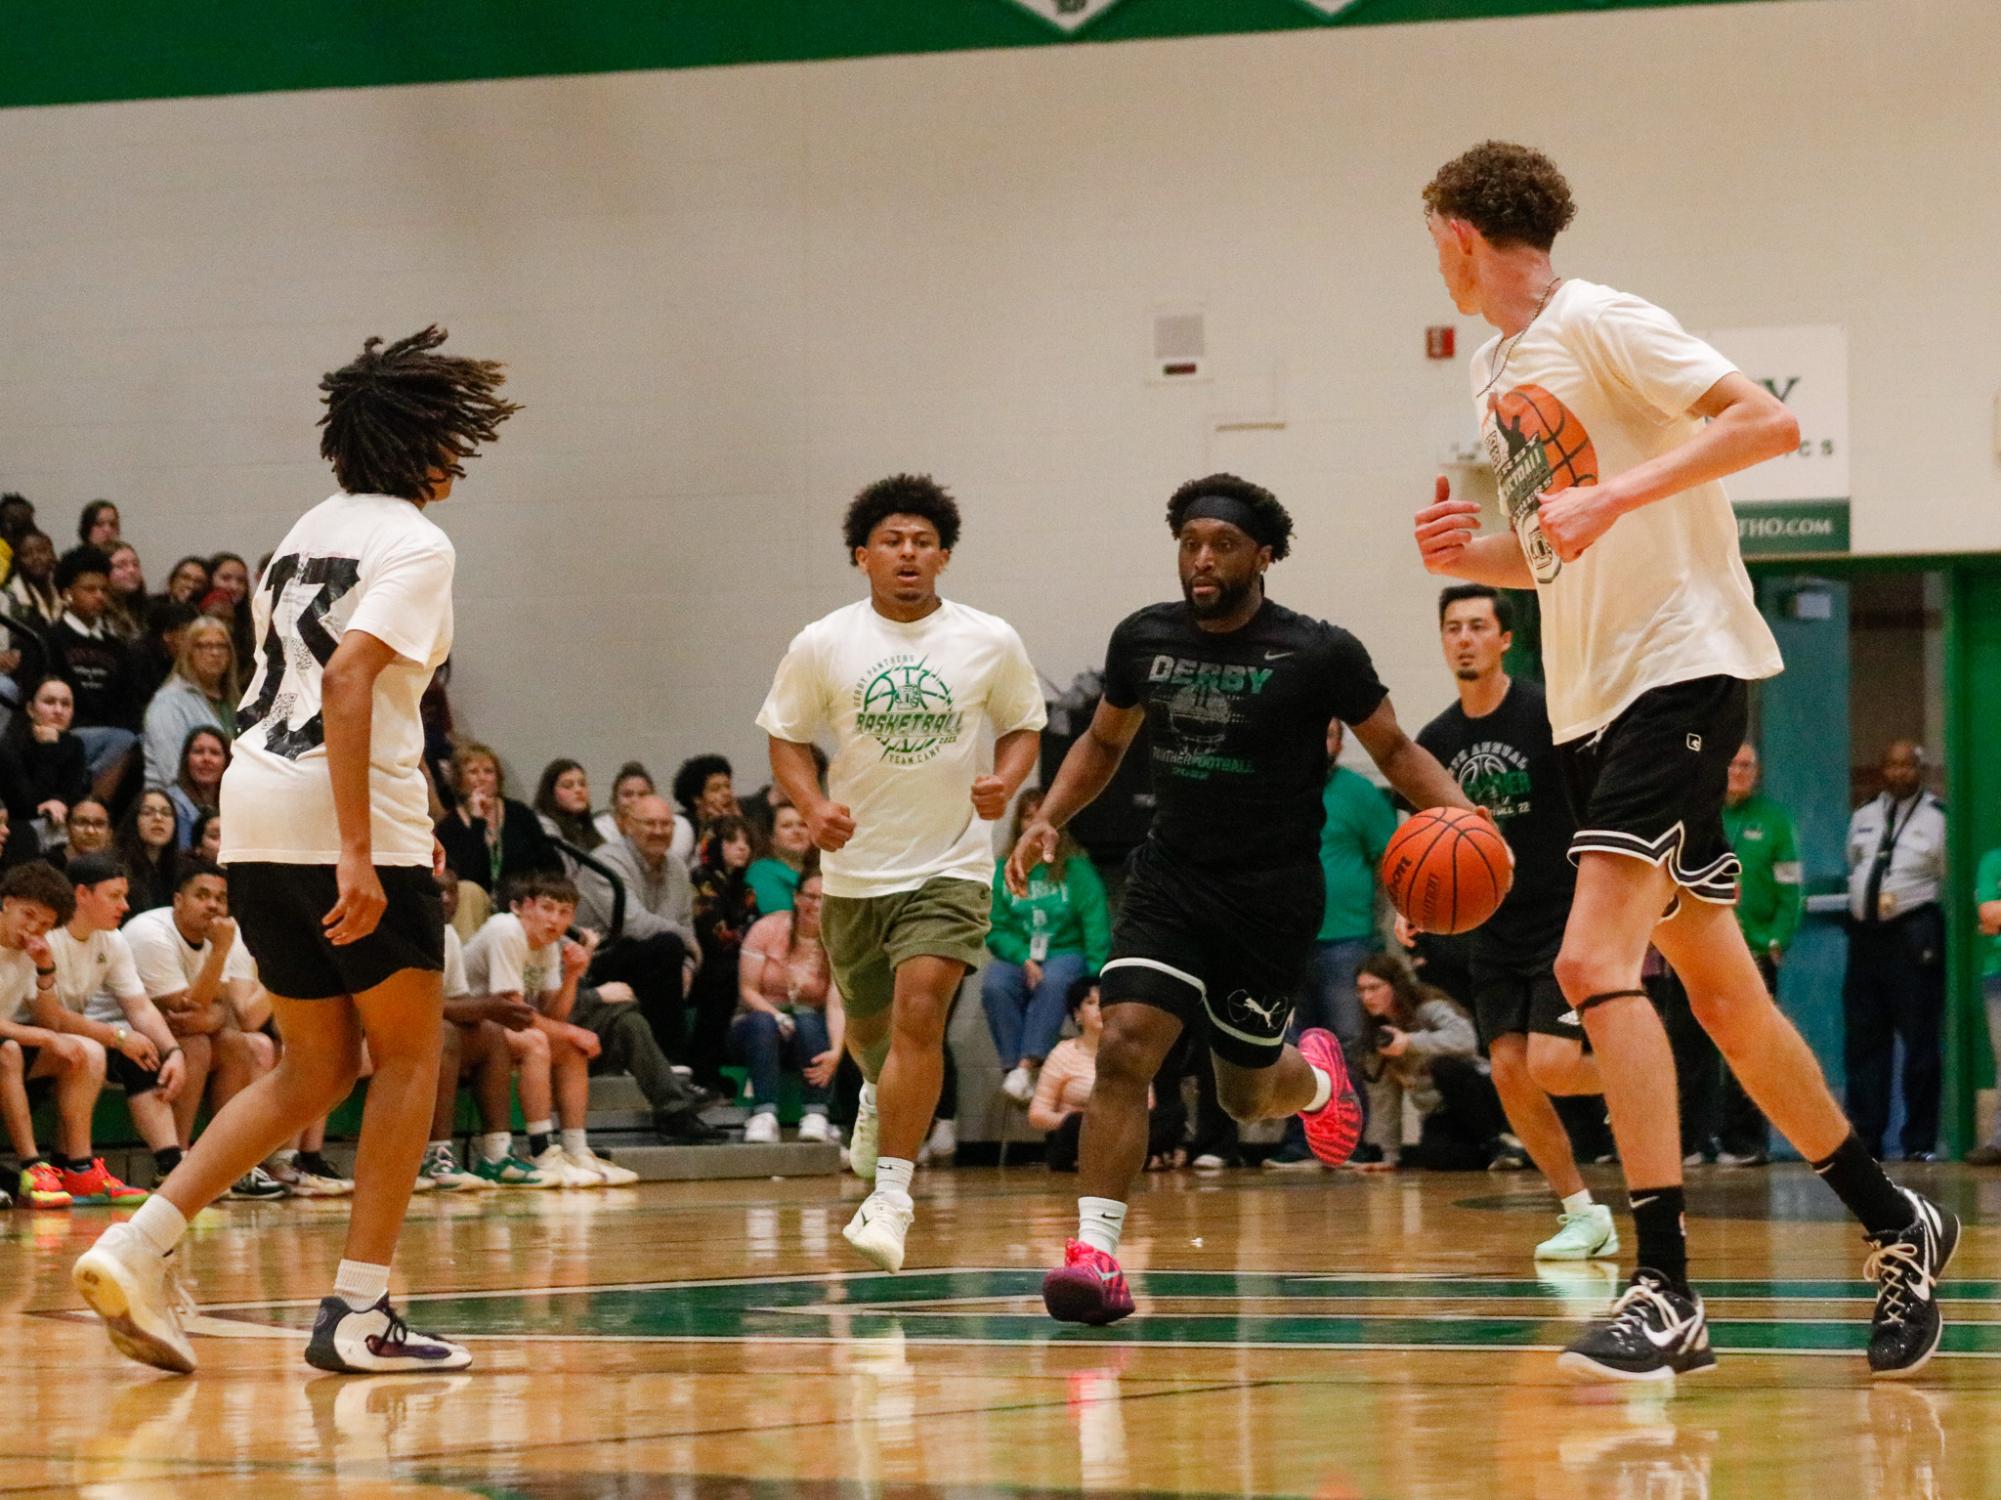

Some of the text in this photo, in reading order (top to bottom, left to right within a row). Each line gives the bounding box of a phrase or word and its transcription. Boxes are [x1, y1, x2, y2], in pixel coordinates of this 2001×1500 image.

[1738, 516, 1833, 537] THO.COM
[1148, 654, 1274, 695] DERBY
[856, 711, 965, 734] BASKETBALL
[888, 745, 942, 766] TEAM CAMP
[1471, 741, 1530, 770] ANNUAL
